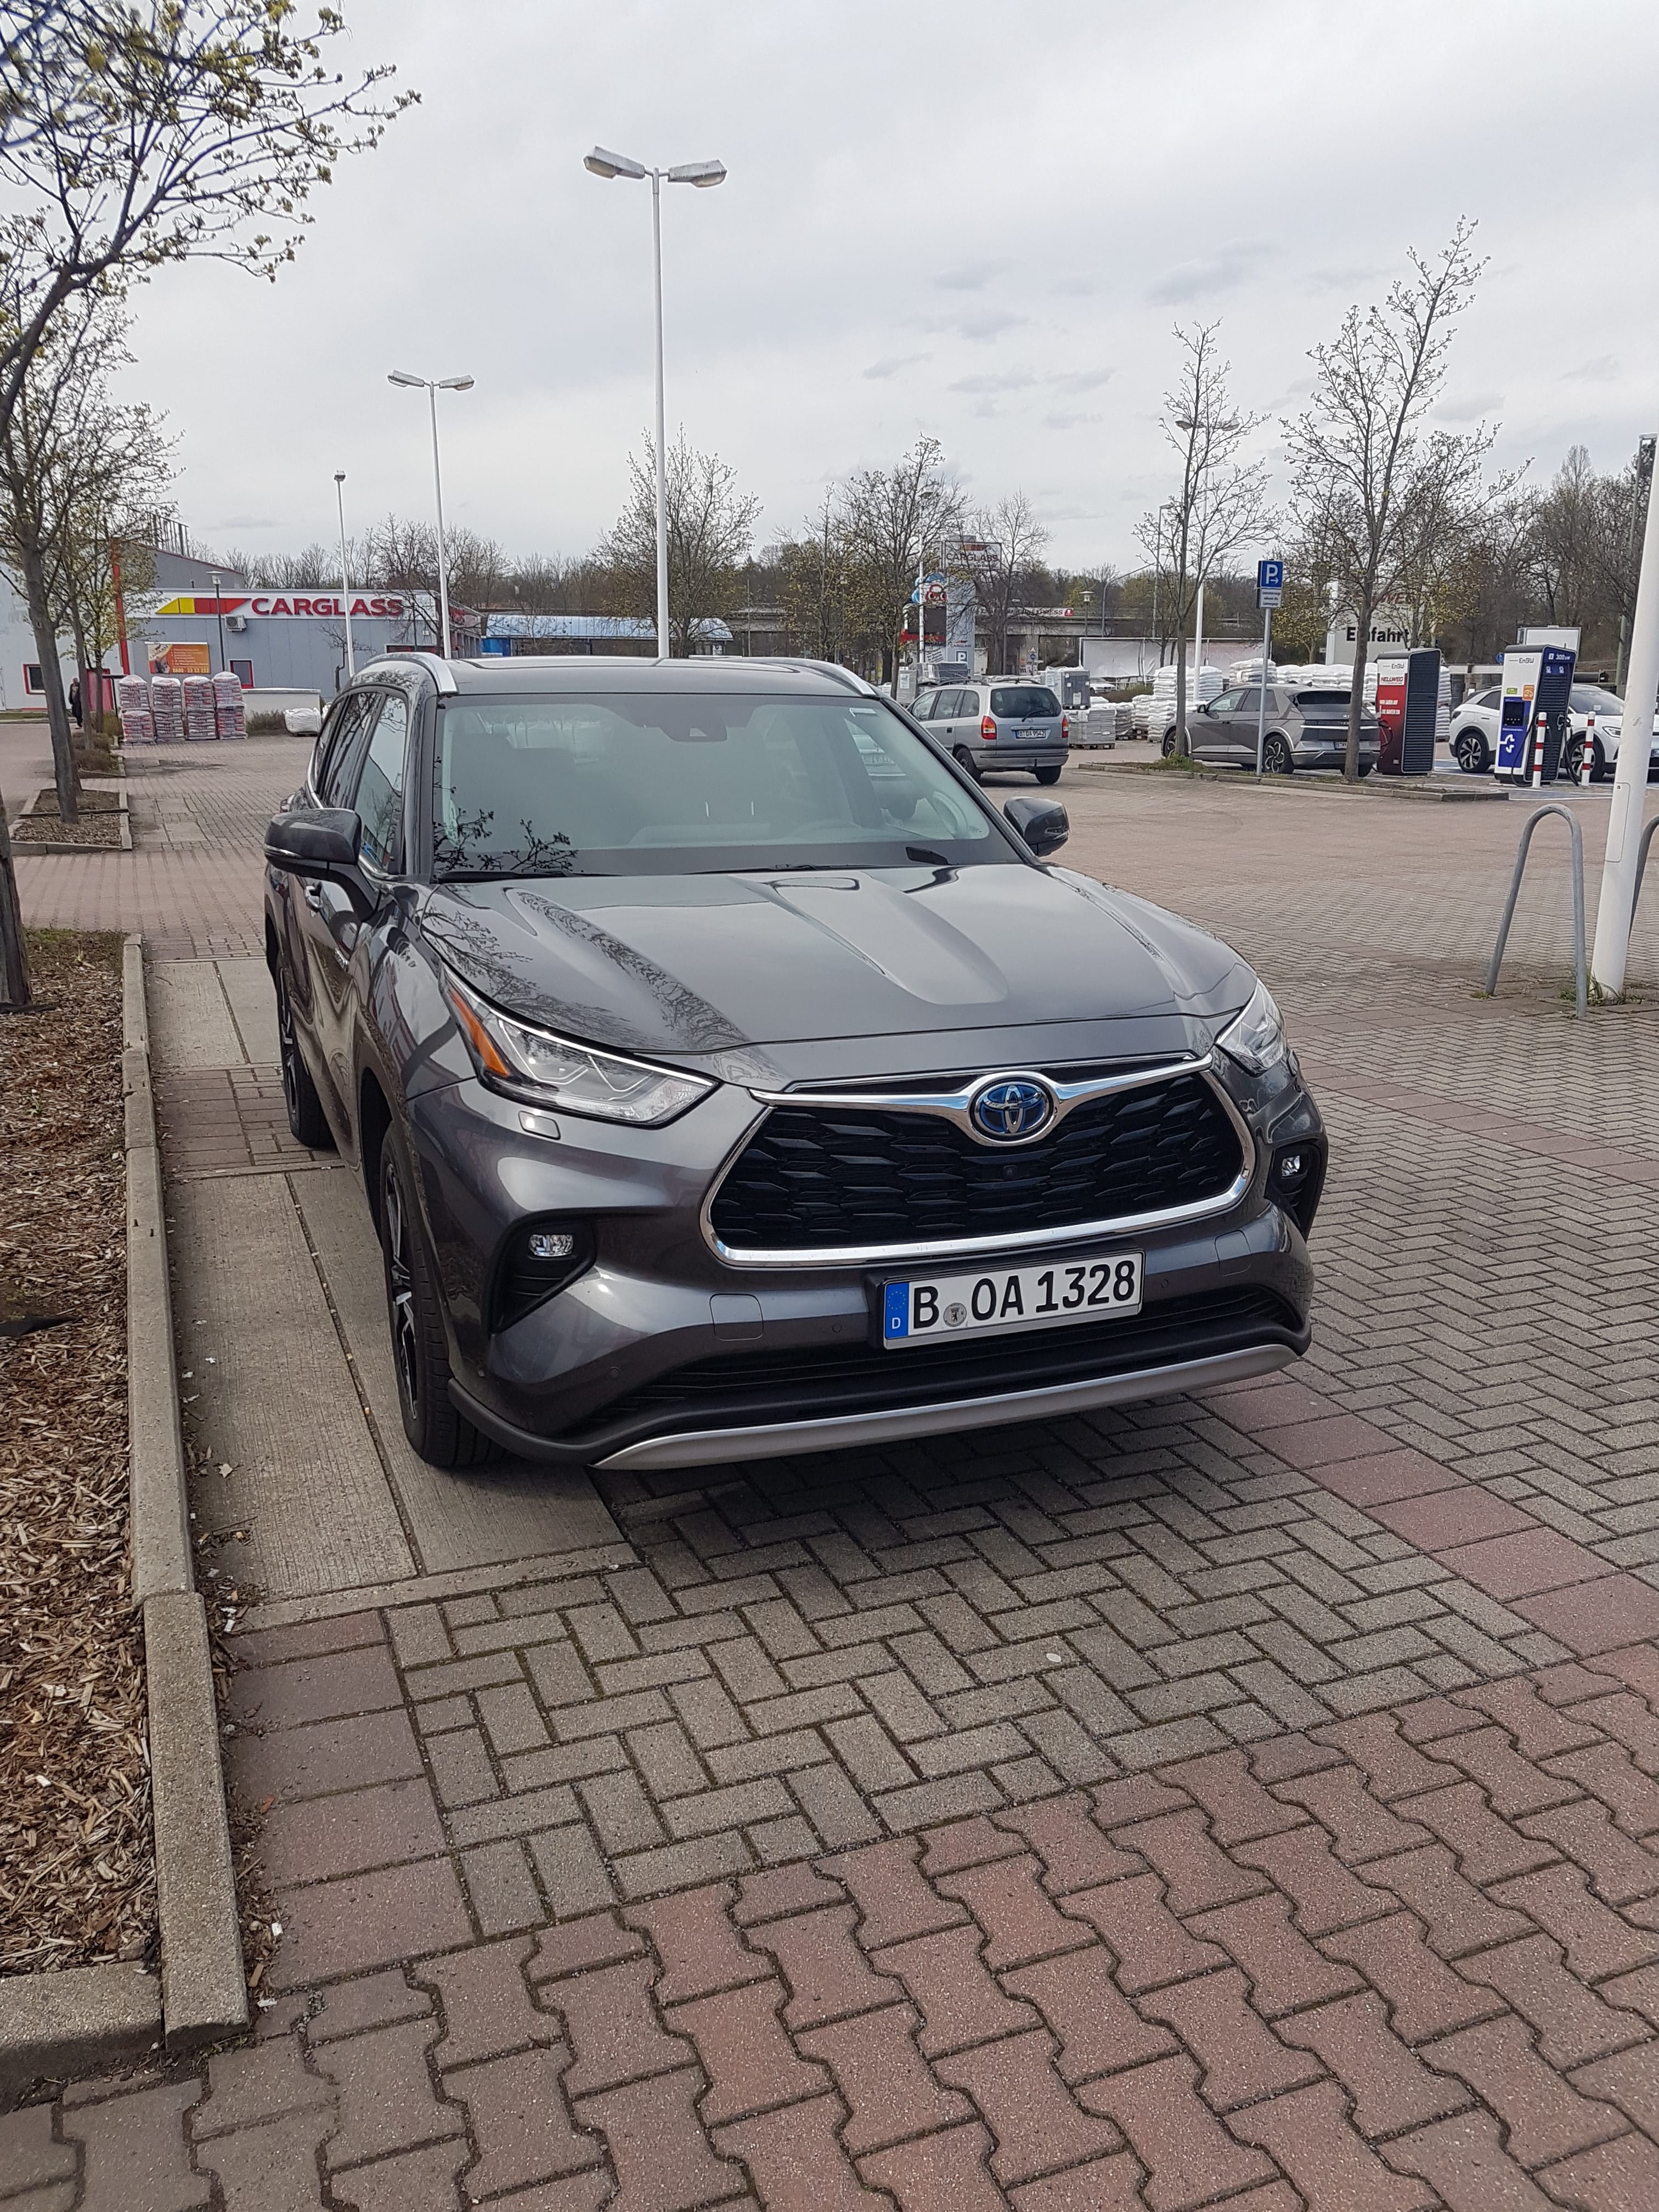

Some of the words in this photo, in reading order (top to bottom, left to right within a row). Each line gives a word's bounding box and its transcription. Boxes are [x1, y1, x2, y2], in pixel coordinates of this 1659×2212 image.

[1266, 563, 1278, 584] P
[251, 597, 403, 616] CARGLASS
[1346, 626, 1410, 642] Efahrt
[958, 652, 966, 662] P
[913, 1285, 940, 1329] B
[971, 1275, 1024, 1321] OA
[1035, 1260, 1136, 1313] 1328
[891, 1317, 901, 1329] D
